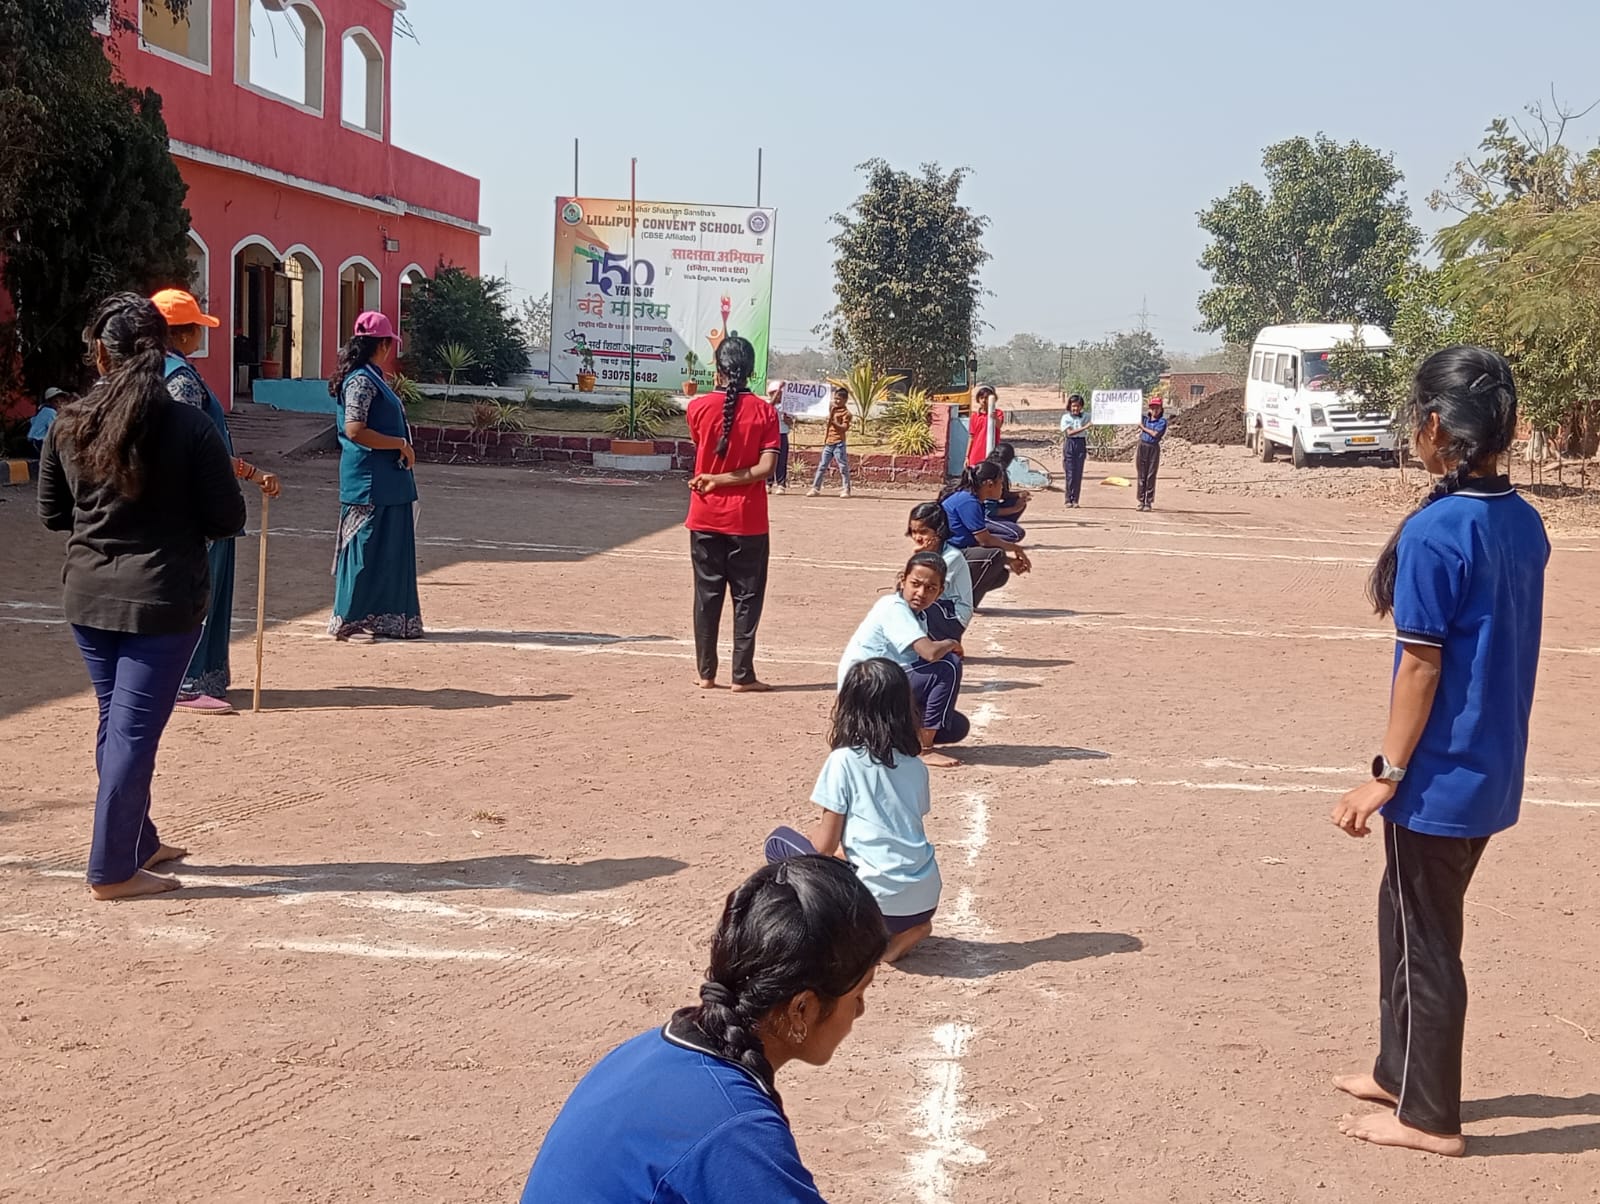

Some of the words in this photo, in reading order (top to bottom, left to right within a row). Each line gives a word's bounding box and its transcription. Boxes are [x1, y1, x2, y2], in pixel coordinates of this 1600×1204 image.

[616, 204, 626, 212] Jai
[652, 206, 682, 215] Shikshan
[684, 208, 716, 217] Sanstha's
[643, 218, 696, 232] CONVENT
[700, 222, 745, 234] SCHOOL
[641, 232, 664, 241] (CBSE
[665, 232, 697, 242] Affiliated)
[672, 248, 715, 262] साक्षरता
[717, 248, 765, 264] अभियान
[644, 287, 654, 298] OF
[577, 292, 605, 318] वंदे
[588, 339, 601, 350] सर्व
[602, 369, 658, 383] 930756482
[787, 382, 827, 398] RAIGAD
[1094, 392, 1140, 403] SINHAGAD
